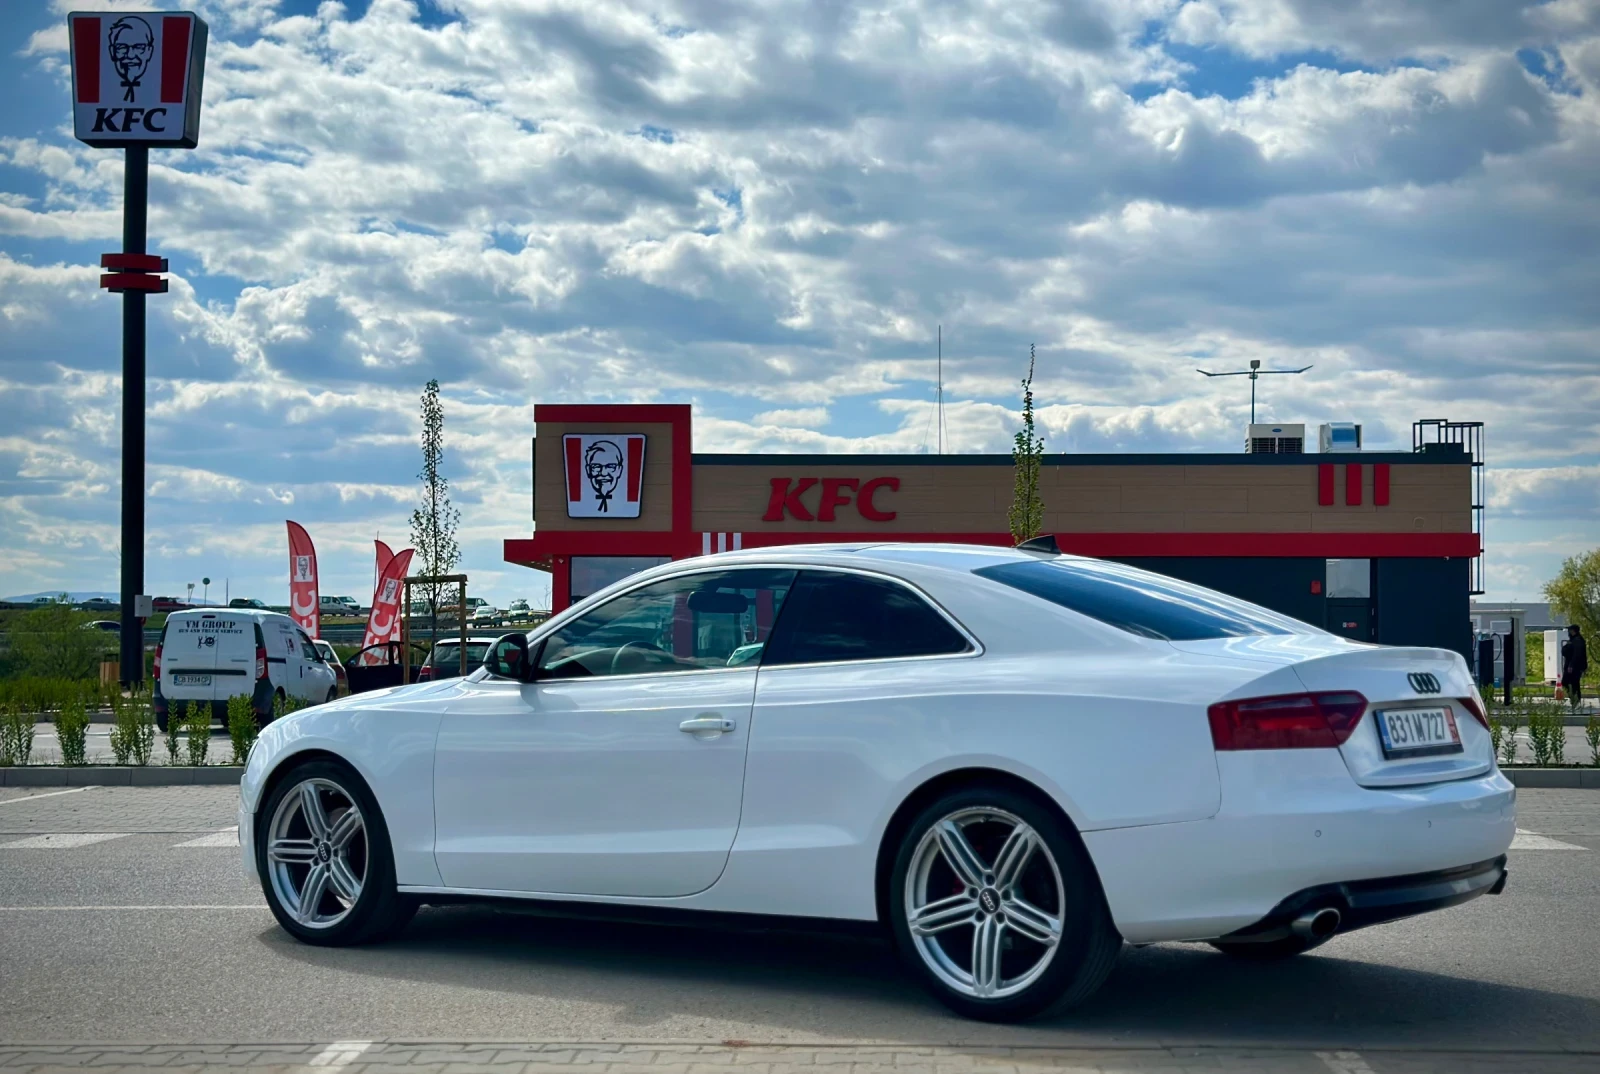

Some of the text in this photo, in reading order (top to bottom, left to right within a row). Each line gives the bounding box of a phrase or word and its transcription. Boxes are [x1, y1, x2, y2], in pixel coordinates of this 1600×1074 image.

[91, 108, 167, 132] KFC
[762, 477, 900, 522] KFC
[186, 620, 236, 629] VM GROUP
